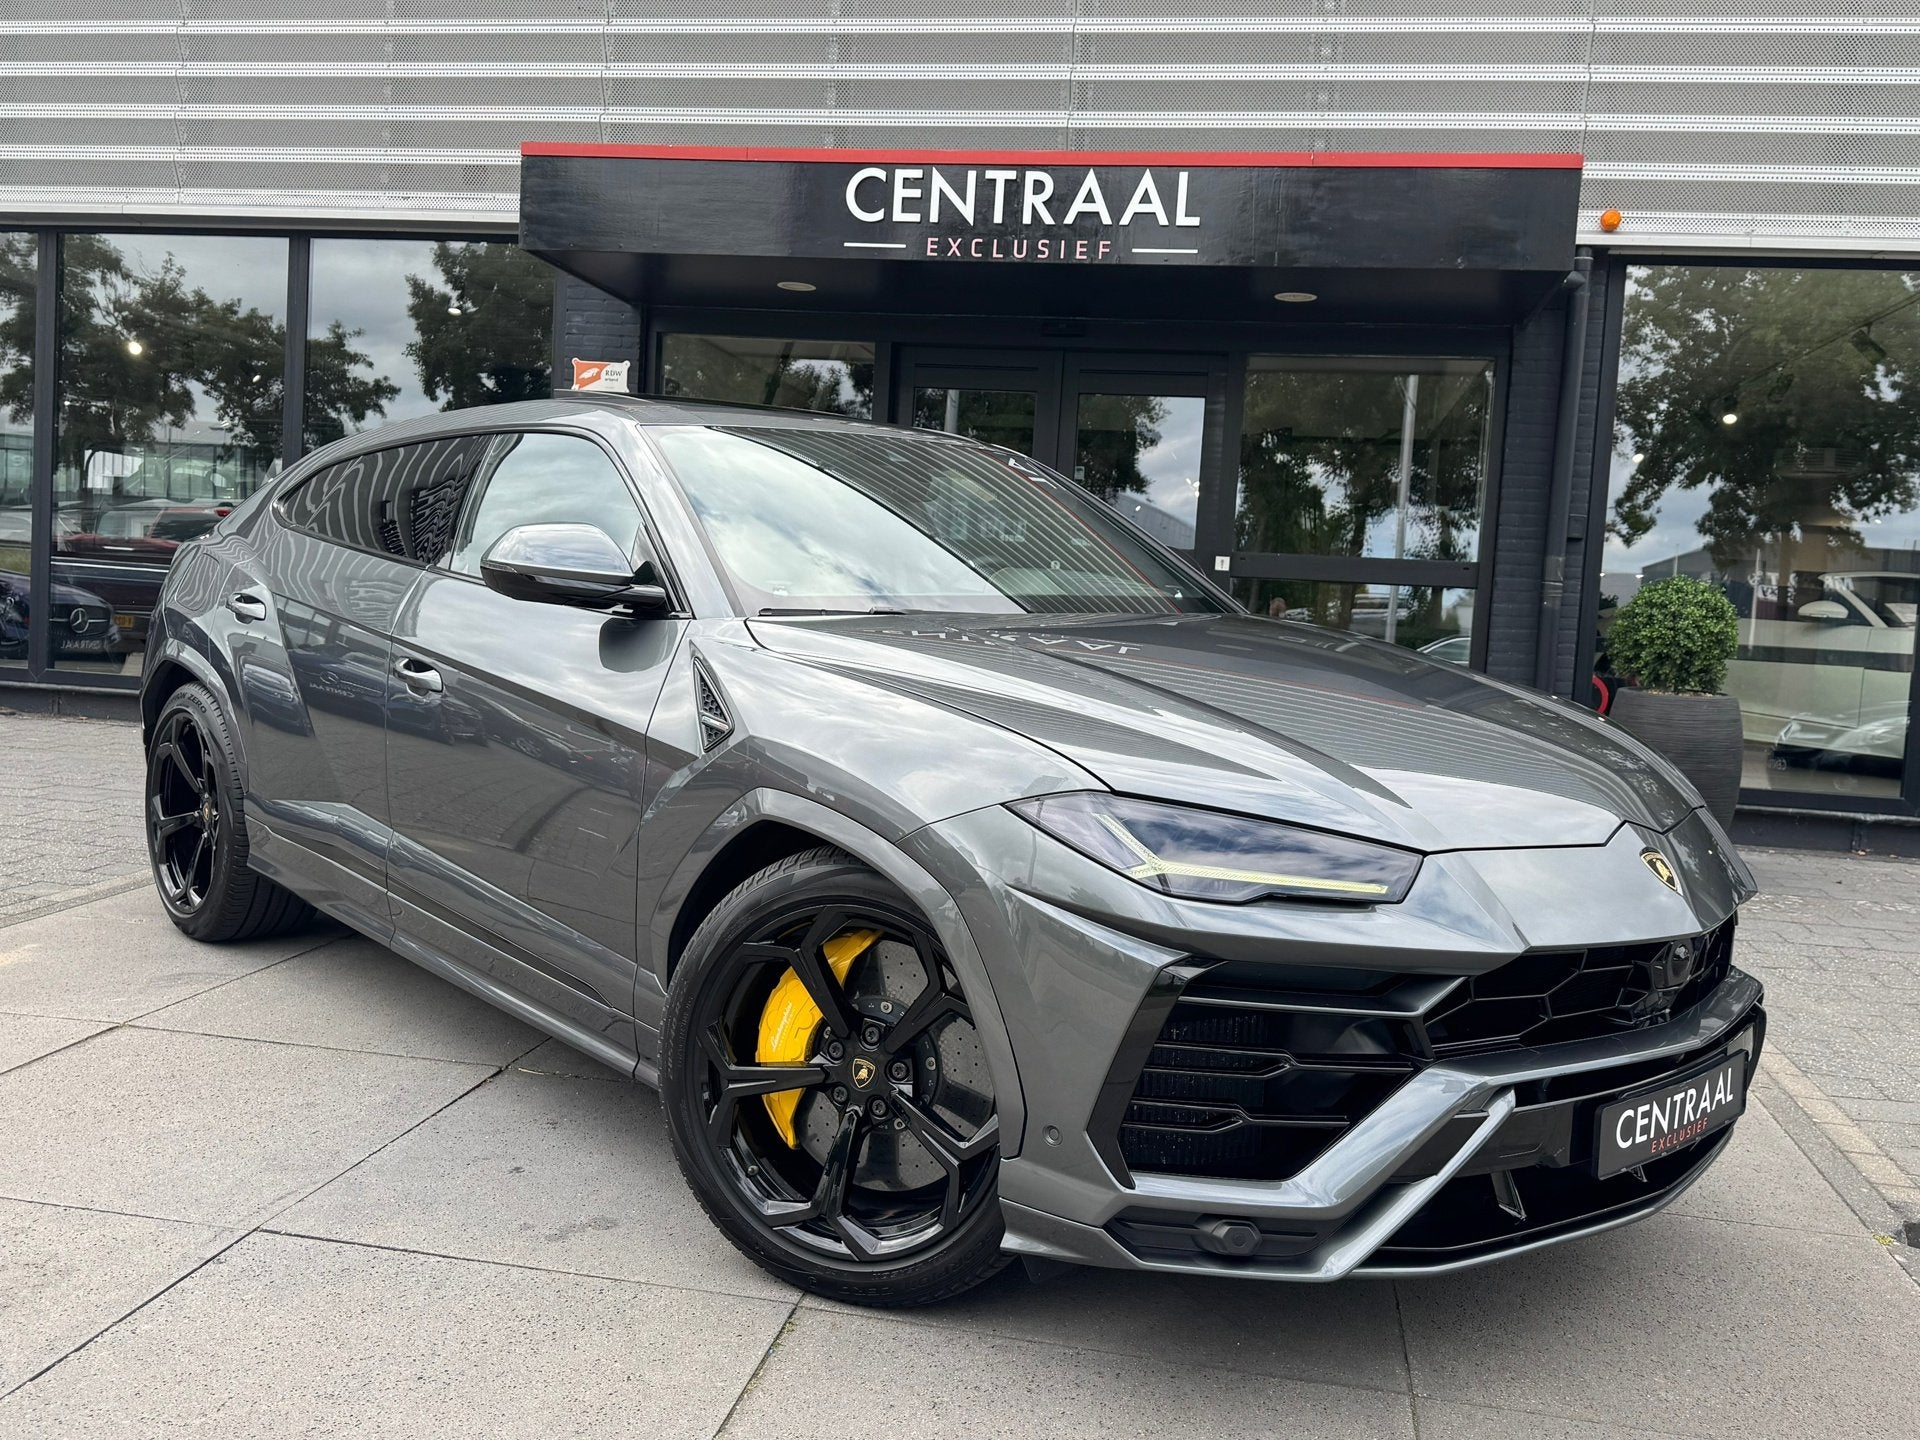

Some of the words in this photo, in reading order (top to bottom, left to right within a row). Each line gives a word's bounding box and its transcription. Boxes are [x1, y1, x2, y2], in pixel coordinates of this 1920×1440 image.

[845, 166, 1201, 227] CENTRAAL
[926, 236, 1112, 260] EXCLUSIEF
[605, 369, 623, 377] RDW
[187, 694, 207, 713] ZERO
[1616, 1067, 1734, 1149] CENTRAAL
[1651, 1117, 1709, 1153] EXCLUSIEF
